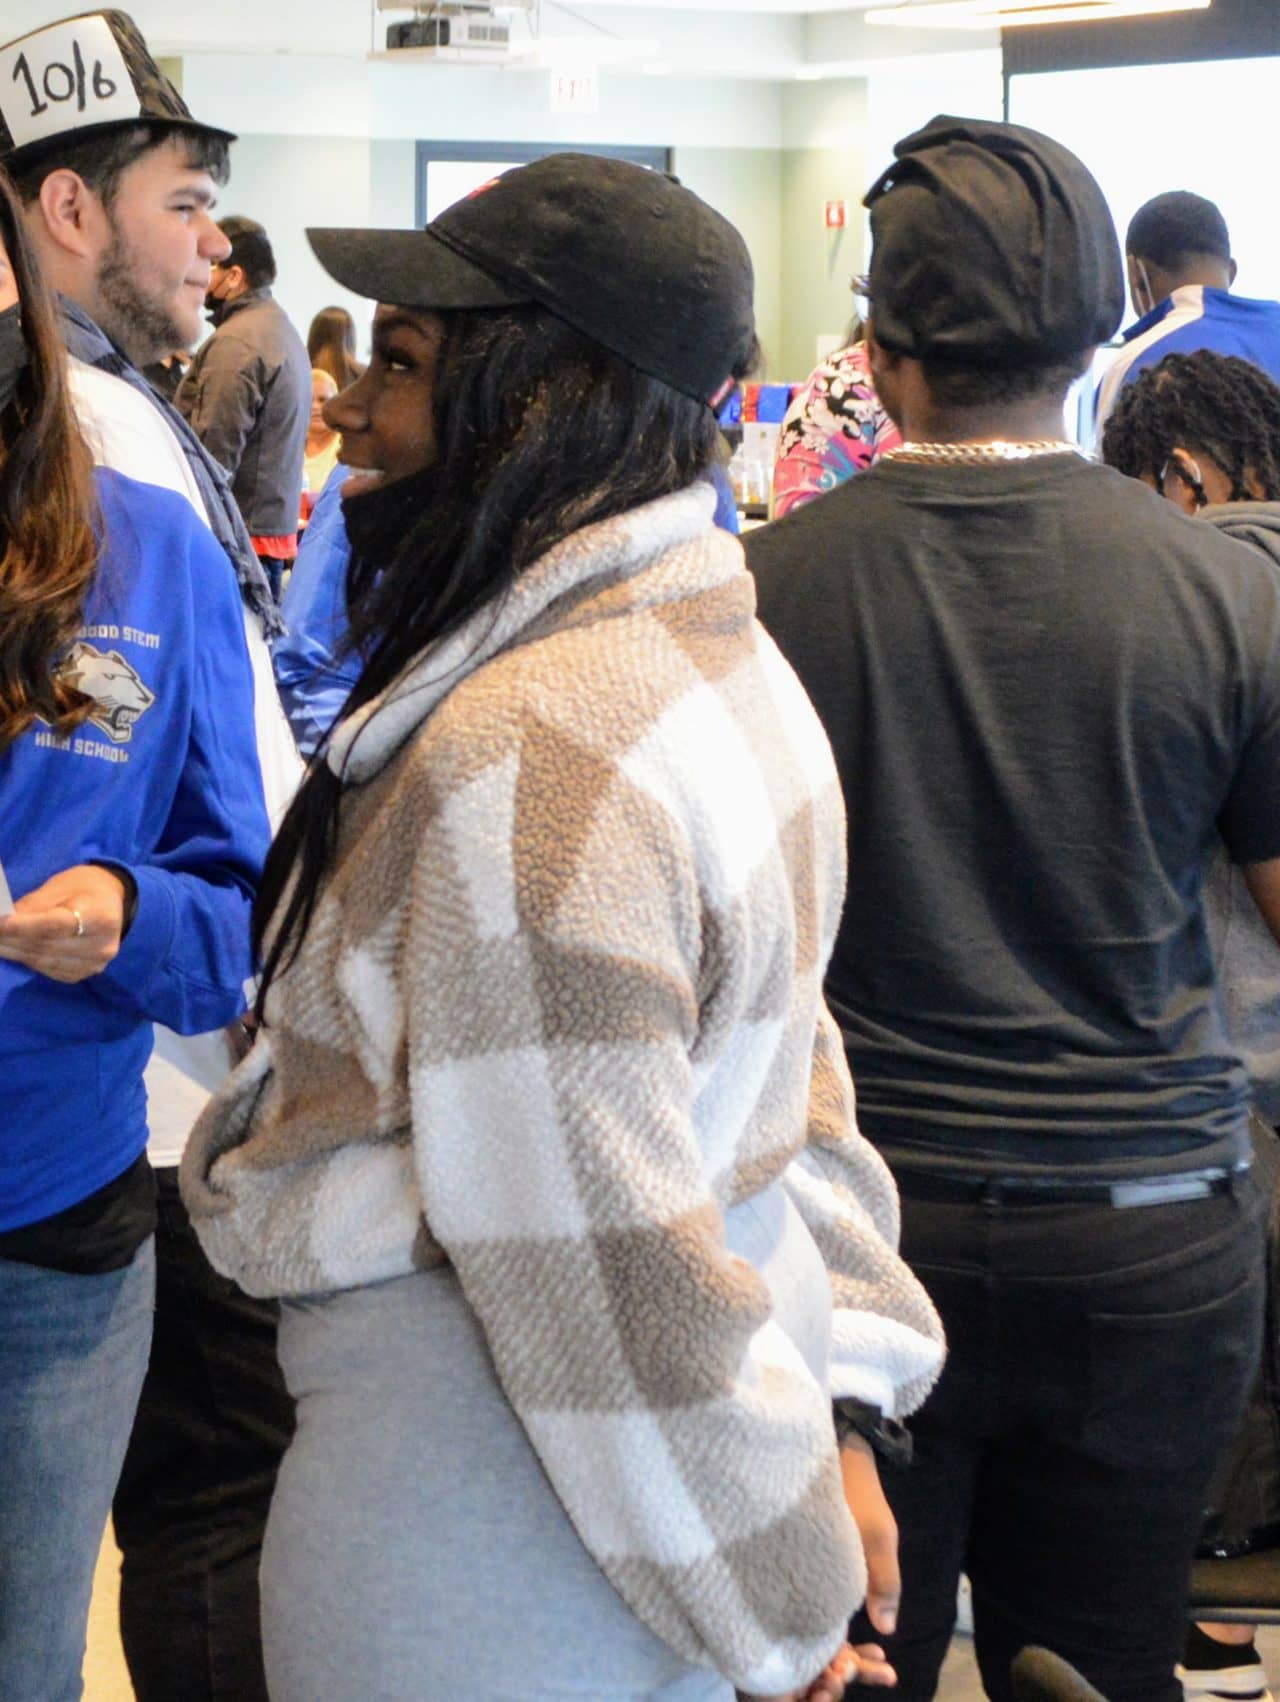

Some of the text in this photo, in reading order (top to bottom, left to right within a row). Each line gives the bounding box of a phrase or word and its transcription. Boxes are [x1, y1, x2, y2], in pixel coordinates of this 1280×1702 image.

[12, 39, 117, 117] 10/6
[122, 626, 160, 649] STEM
[74, 738, 129, 763] SCHOOL
